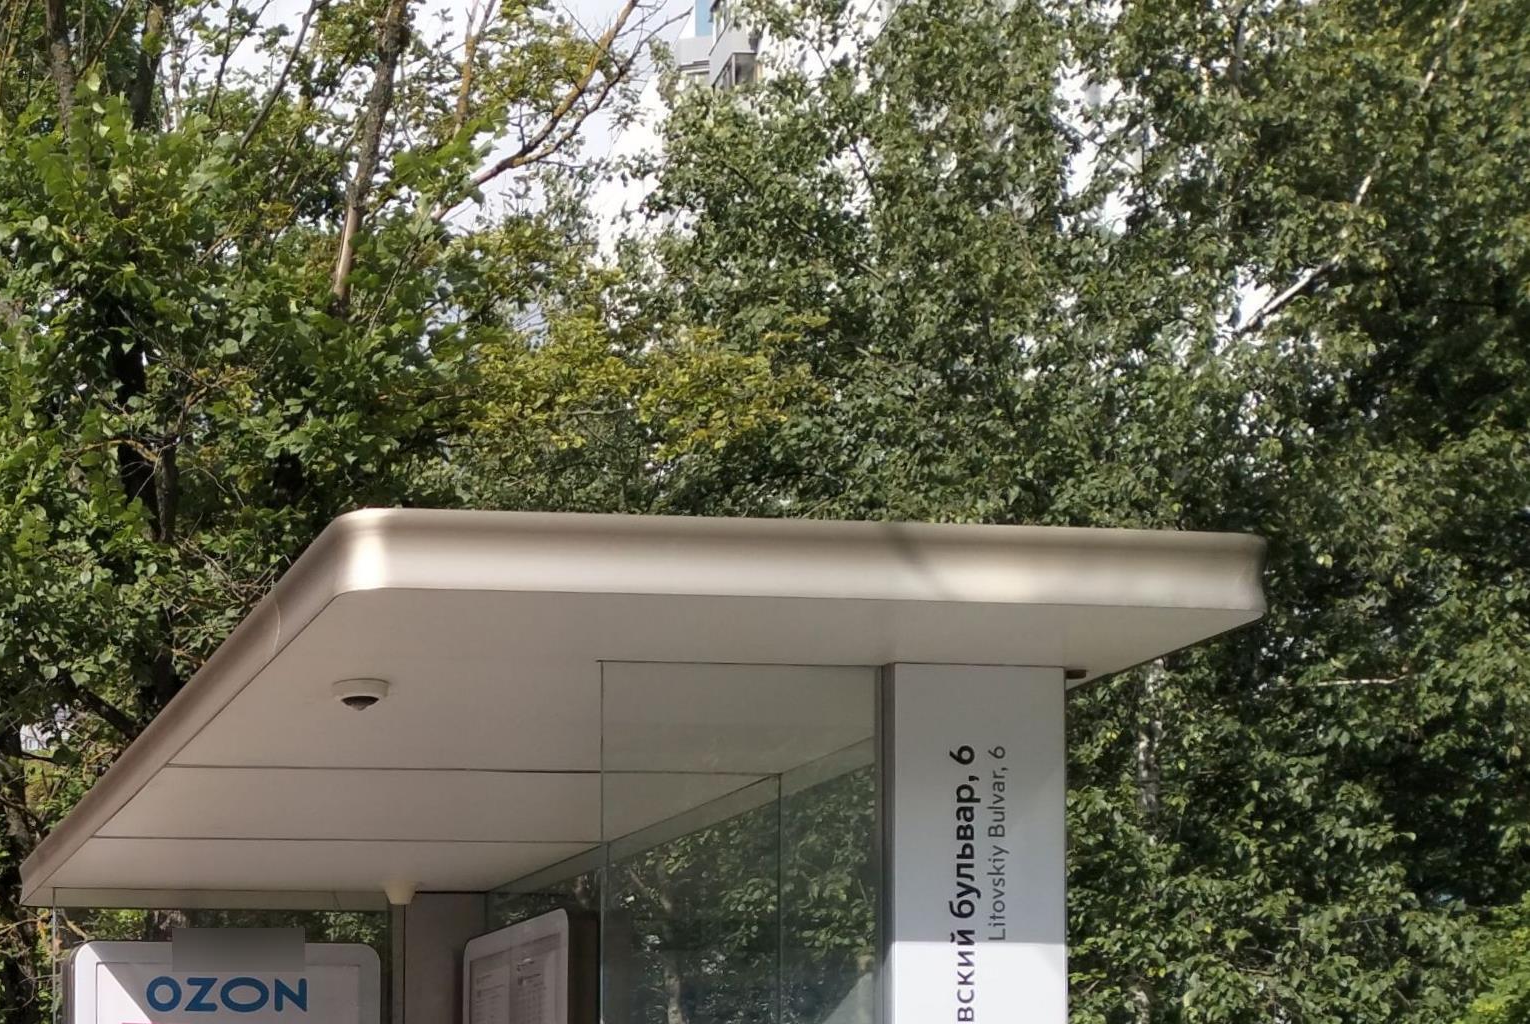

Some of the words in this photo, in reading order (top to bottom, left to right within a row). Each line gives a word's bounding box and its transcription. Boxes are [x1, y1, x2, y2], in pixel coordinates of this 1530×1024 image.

[949, 745, 975, 765] 6
[988, 746, 1006, 760] 6
[987, 767, 1009, 838] Bulvar,
[949, 775, 981, 919] бульвар,
[987, 845, 1010, 941] Litovskiy
[146, 976, 308, 1013] OZON
